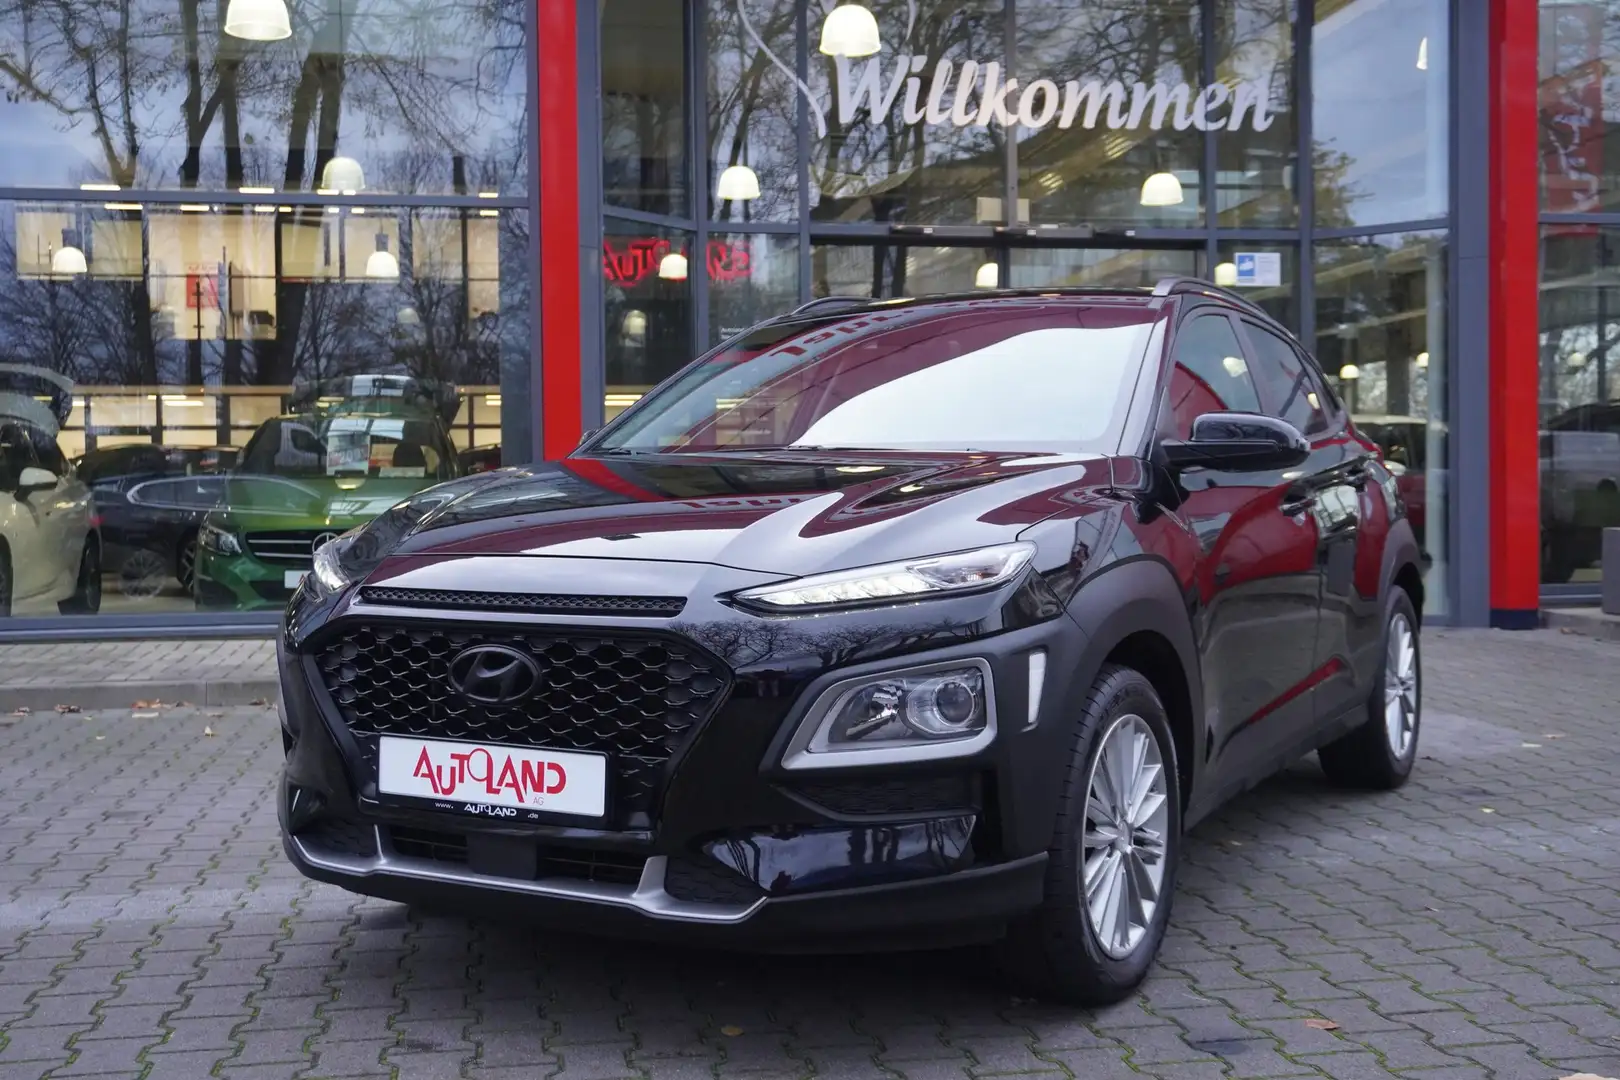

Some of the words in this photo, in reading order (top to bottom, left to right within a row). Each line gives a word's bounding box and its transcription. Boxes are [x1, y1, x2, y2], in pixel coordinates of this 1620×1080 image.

[832, 53, 1275, 132] Willkommen
[412, 745, 567, 803] AUTOLAND
[464, 803, 518, 817] AUTOLAND
[533, 796, 545, 806] AG
